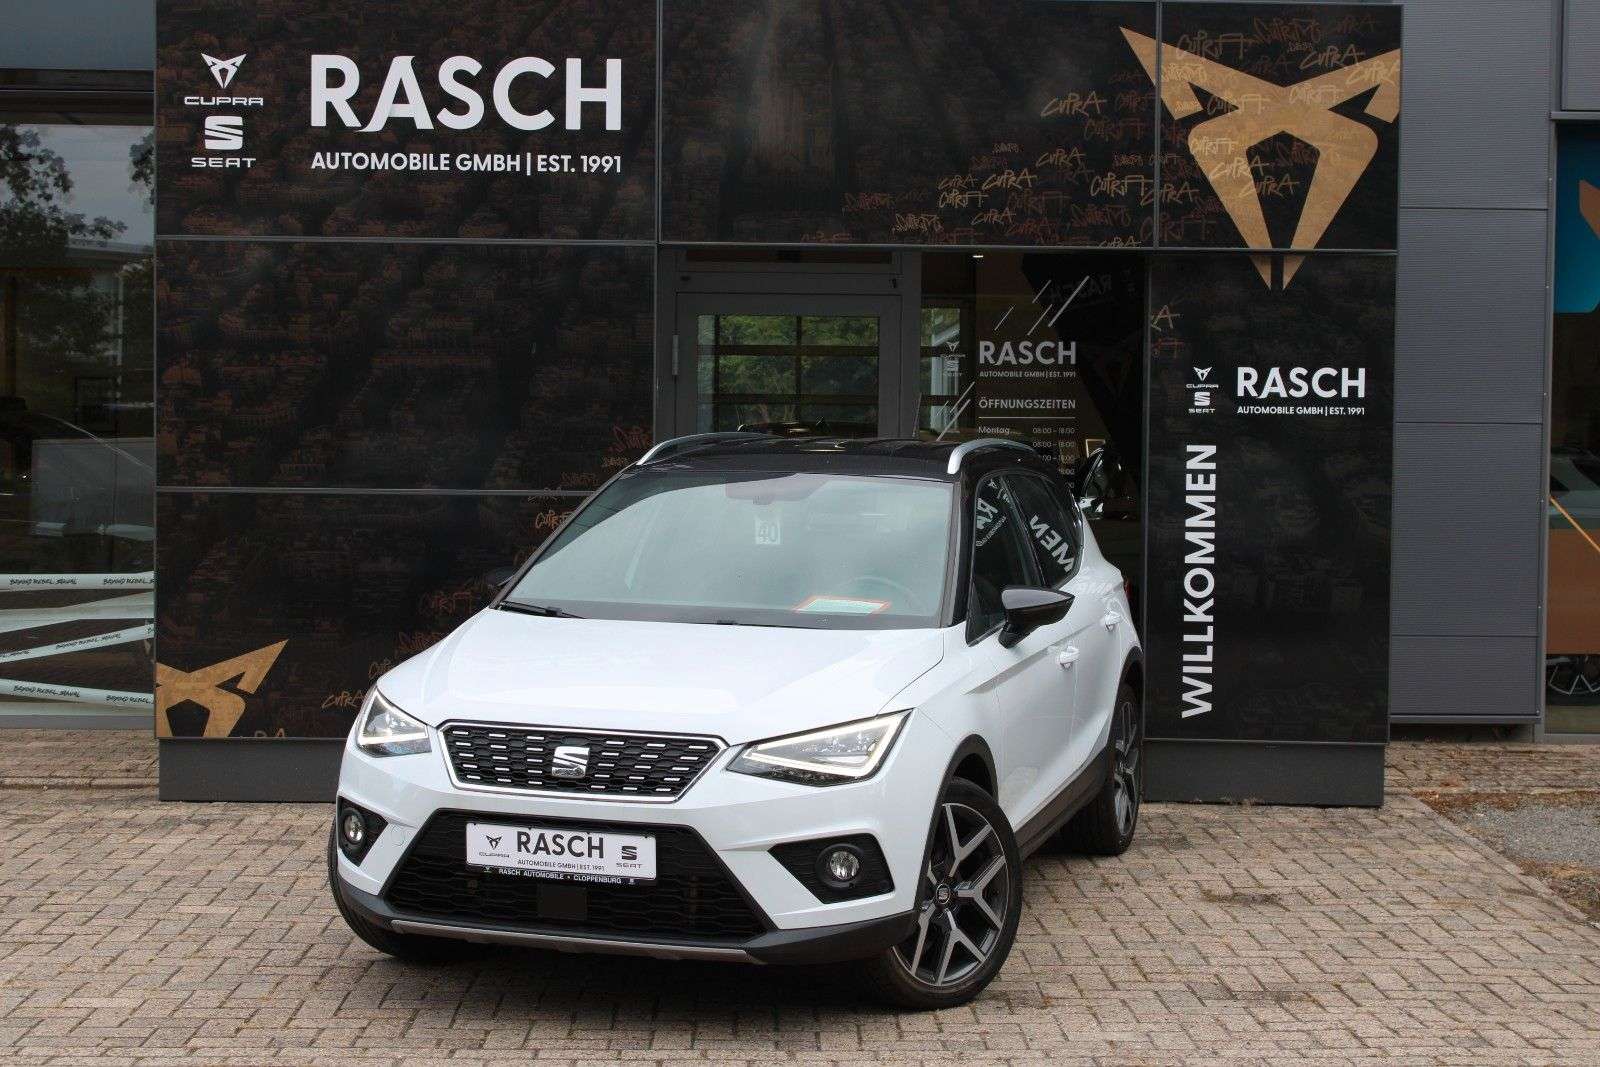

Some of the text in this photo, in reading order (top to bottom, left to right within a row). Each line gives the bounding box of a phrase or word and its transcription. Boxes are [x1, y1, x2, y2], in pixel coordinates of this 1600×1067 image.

[310, 54, 622, 133] RASCH
[184, 95, 264, 106] CUPRA
[191, 157, 256, 168] SEAT
[310, 152, 450, 172] AUTOMOBILE
[455, 155, 521, 173] GMBH
[537, 155, 575, 174] EST.
[581, 156, 622, 174] 1991
[978, 340, 1077, 366] RASCH
[1024, 371, 1044, 379] GMBH
[1237, 367, 1365, 399] RASCH
[978, 396, 1076, 410] ÖFFNUNGSZEITEN
[1237, 405, 1295, 415] AUTOMOBILE
[1296, 406, 1324, 416] GMBH
[1329, 407, 1346, 416] EST.
[1348, 407, 1365, 416] 1991
[978, 425, 1010, 435] Montag
[1181, 444, 1217, 719] WILLKOMMEN
[516, 831, 604, 859] RASCH
[517, 859, 557, 868] AUTOMOBILE
[557, 862, 577, 870] GMBH
[523, 871, 564, 880] AUTOMOBILE
[573, 875, 622, 884] CLOPPENBURG
